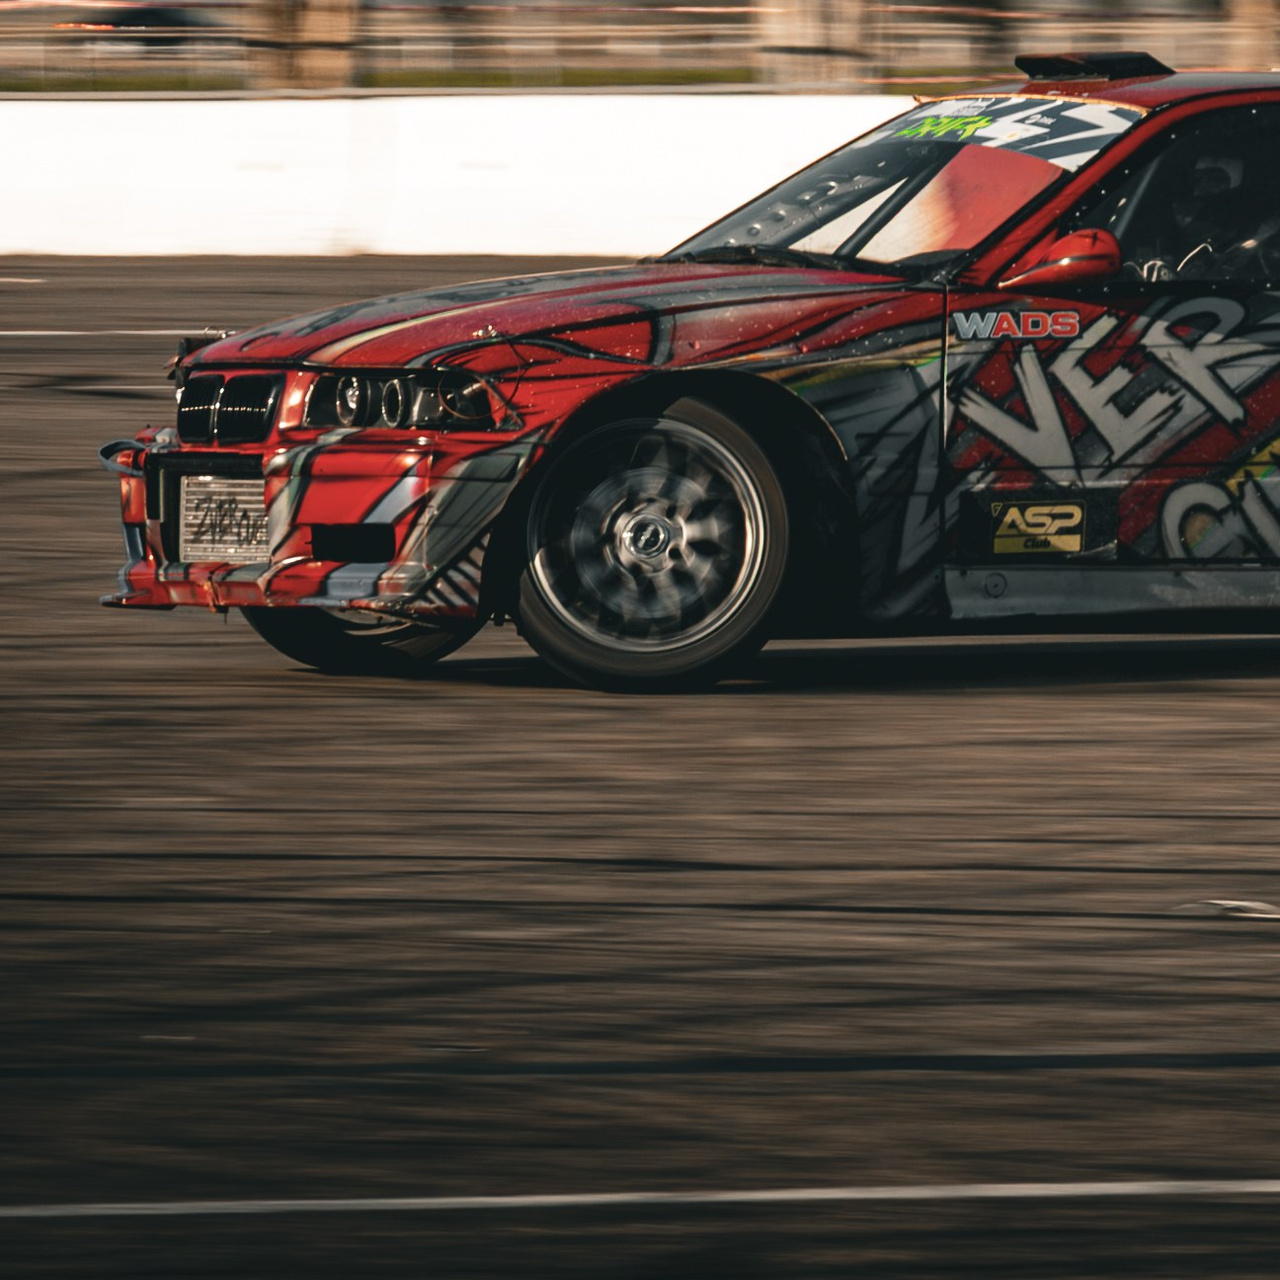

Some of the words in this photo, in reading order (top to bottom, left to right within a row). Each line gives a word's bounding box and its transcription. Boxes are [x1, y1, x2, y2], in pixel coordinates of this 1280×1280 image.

[953, 311, 1080, 338] WADS
[996, 505, 1083, 535] ASP
[1024, 537, 1051, 550] Club
